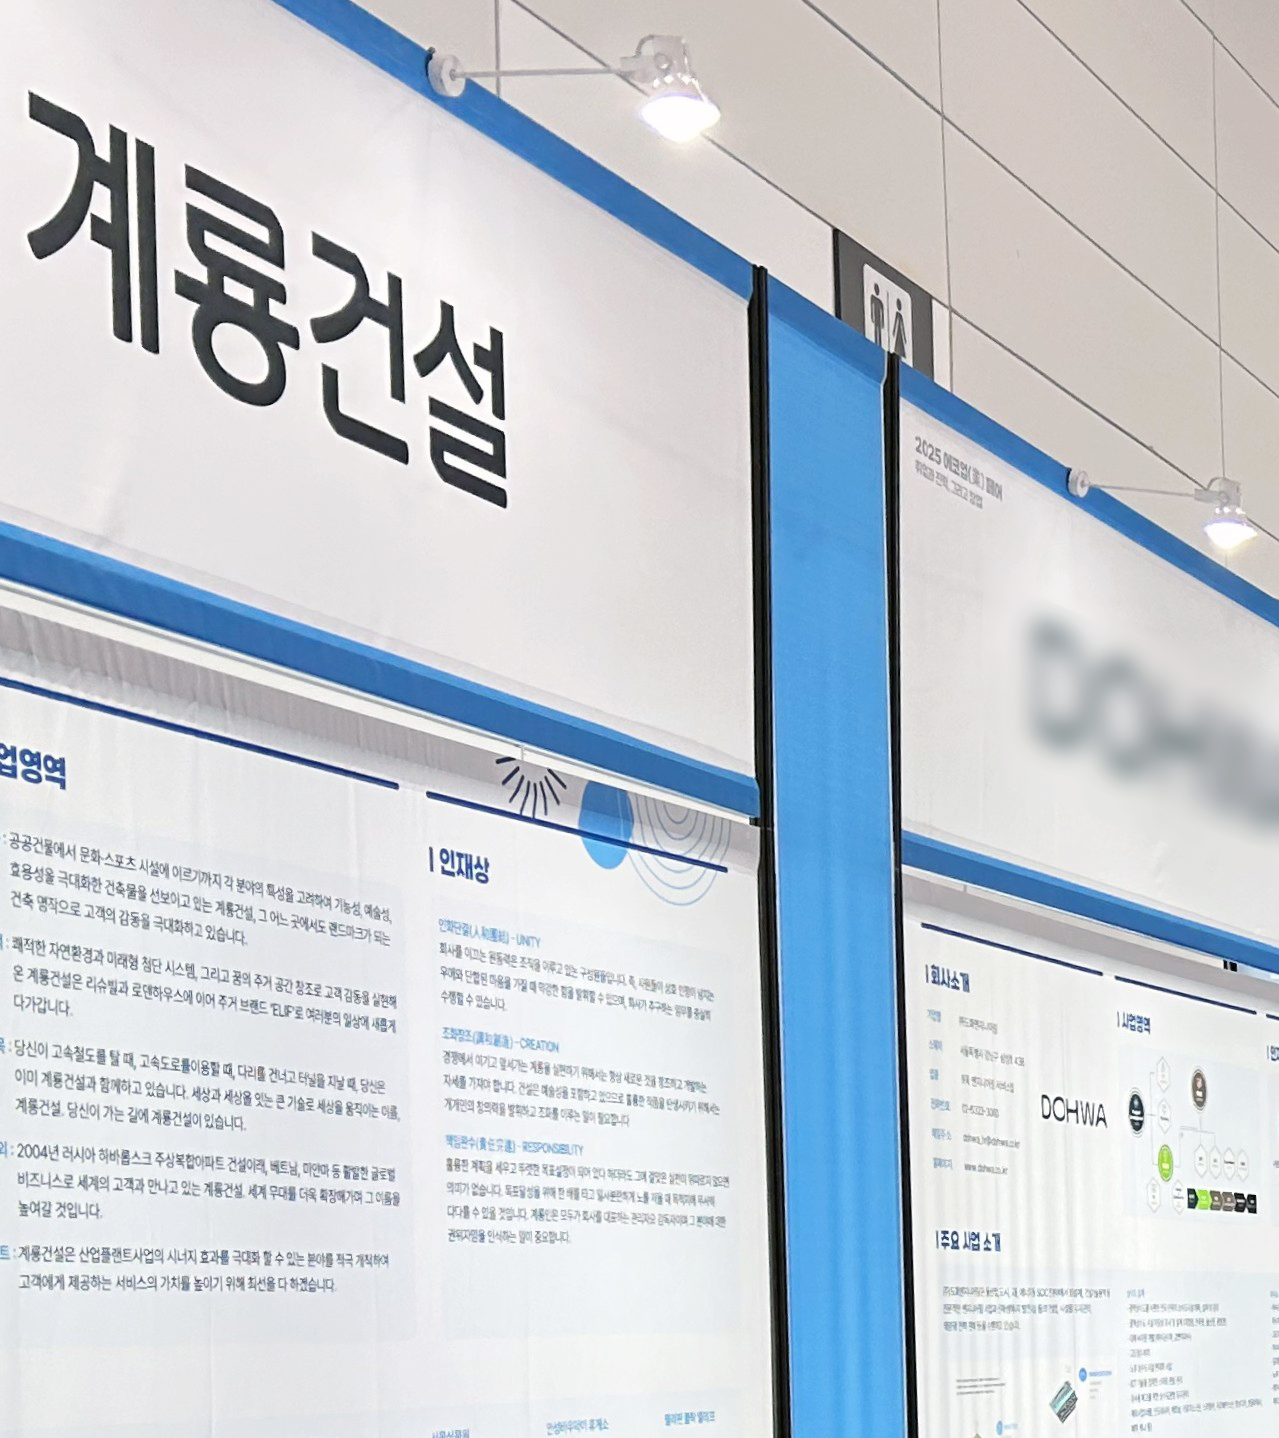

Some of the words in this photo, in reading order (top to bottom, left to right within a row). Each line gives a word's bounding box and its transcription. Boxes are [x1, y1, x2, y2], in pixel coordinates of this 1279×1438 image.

[26, 90, 508, 510] 계룡건설
[915, 436, 942, 465] 2025
[986, 476, 1003, 501] 페어
[0, 743, 66, 790] 업영역
[439, 852, 490, 884] 인재상
[10, 862, 55, 886] 효용성을
[58, 871, 102, 894] 극대화한
[105, 880, 147, 902] 건축물을
[150, 888, 191, 910] 선보이고
[192, 896, 212, 914] 있는
[215, 900, 256, 922] 계룡건설,
[259, 908, 267, 924] 그
[269, 910, 288, 928] 어느
[11, 891, 34, 911] 건축
[36, 896, 81, 919] 명작으로
[84, 904, 116, 925] 고객의
[119, 909, 151, 931] 감동을
[154, 915, 203, 939] 극대화하고
[205, 924, 247, 946] 있습니다.
[12, 936, 46, 958] 쾌적한
[49, 942, 104, 966] 자연환경과
[106, 950, 139, 971] 미래형
[142, 956, 162, 975] 첨단
[165, 959, 198, 980] 시스템,
[201, 965, 230, 985] 그리고
[232, 969, 252, 988] 꿈의
[254, 973, 273, 991] 주거
[275, 976, 293, 994] 공간
[295, 979, 323, 998] 창조로
[931, 964, 970, 993] 회사소개
[13, 995, 72, 1017] 다가갑니다.
[1122, 1012, 1151, 1035] 사업영역
[15, 1098, 64, 1118] 계룡건설.
[66, 1102, 101, 1121] 당신이
[103, 1105, 124, 1123] 가는
[127, 1107, 150, 1125] 길에
[151, 1109, 202, 1129] 계룡건설이
[204, 1113, 246, 1132] 있습니다.
[1042, 1094, 1108, 1128] DOHWA
[18, 1200, 52, 1218] 높여갈
[55, 1201, 102, 1219] 것입니다.
[940, 1231, 960, 1250] 주요
[962, 1231, 981, 1252] 사업
[983, 1233, 1001, 1253] 소개
[19, 1275, 66, 1291] 고객에게
[68, 1275, 112, 1291] 제공하는
[116, 1276, 158, 1291] 서비스의
[160, 1276, 191, 1292] 가치를
[193, 1277, 223, 1292] 높이기
[225, 1277, 246, 1292] 위해
